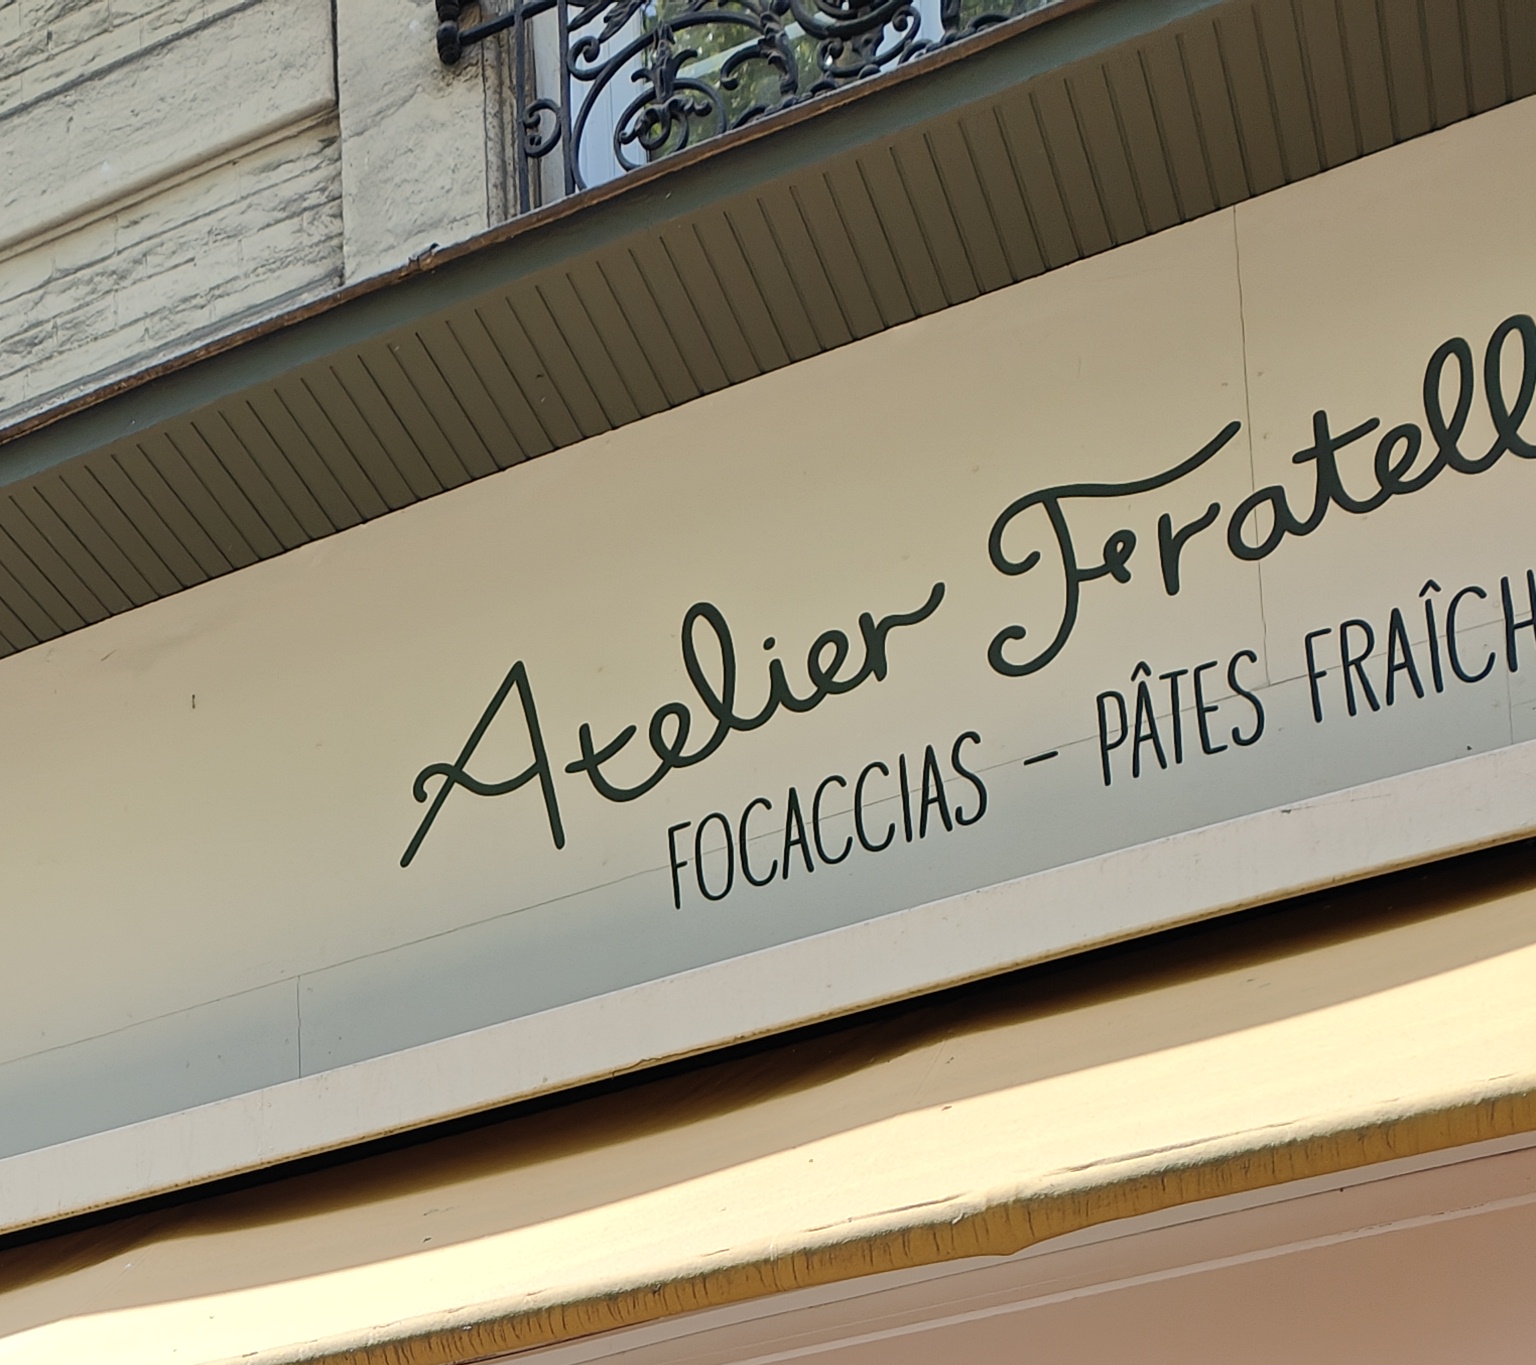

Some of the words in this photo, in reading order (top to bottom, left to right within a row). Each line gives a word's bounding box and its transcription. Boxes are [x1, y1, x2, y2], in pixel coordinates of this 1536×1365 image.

[400, 582, 946, 869] Atelier
[667, 732, 987, 911] FOCACCIAS
[1097, 649, 1266, 787] PÂTES
[1304, 570, 1536, 725] FRAÎCH
